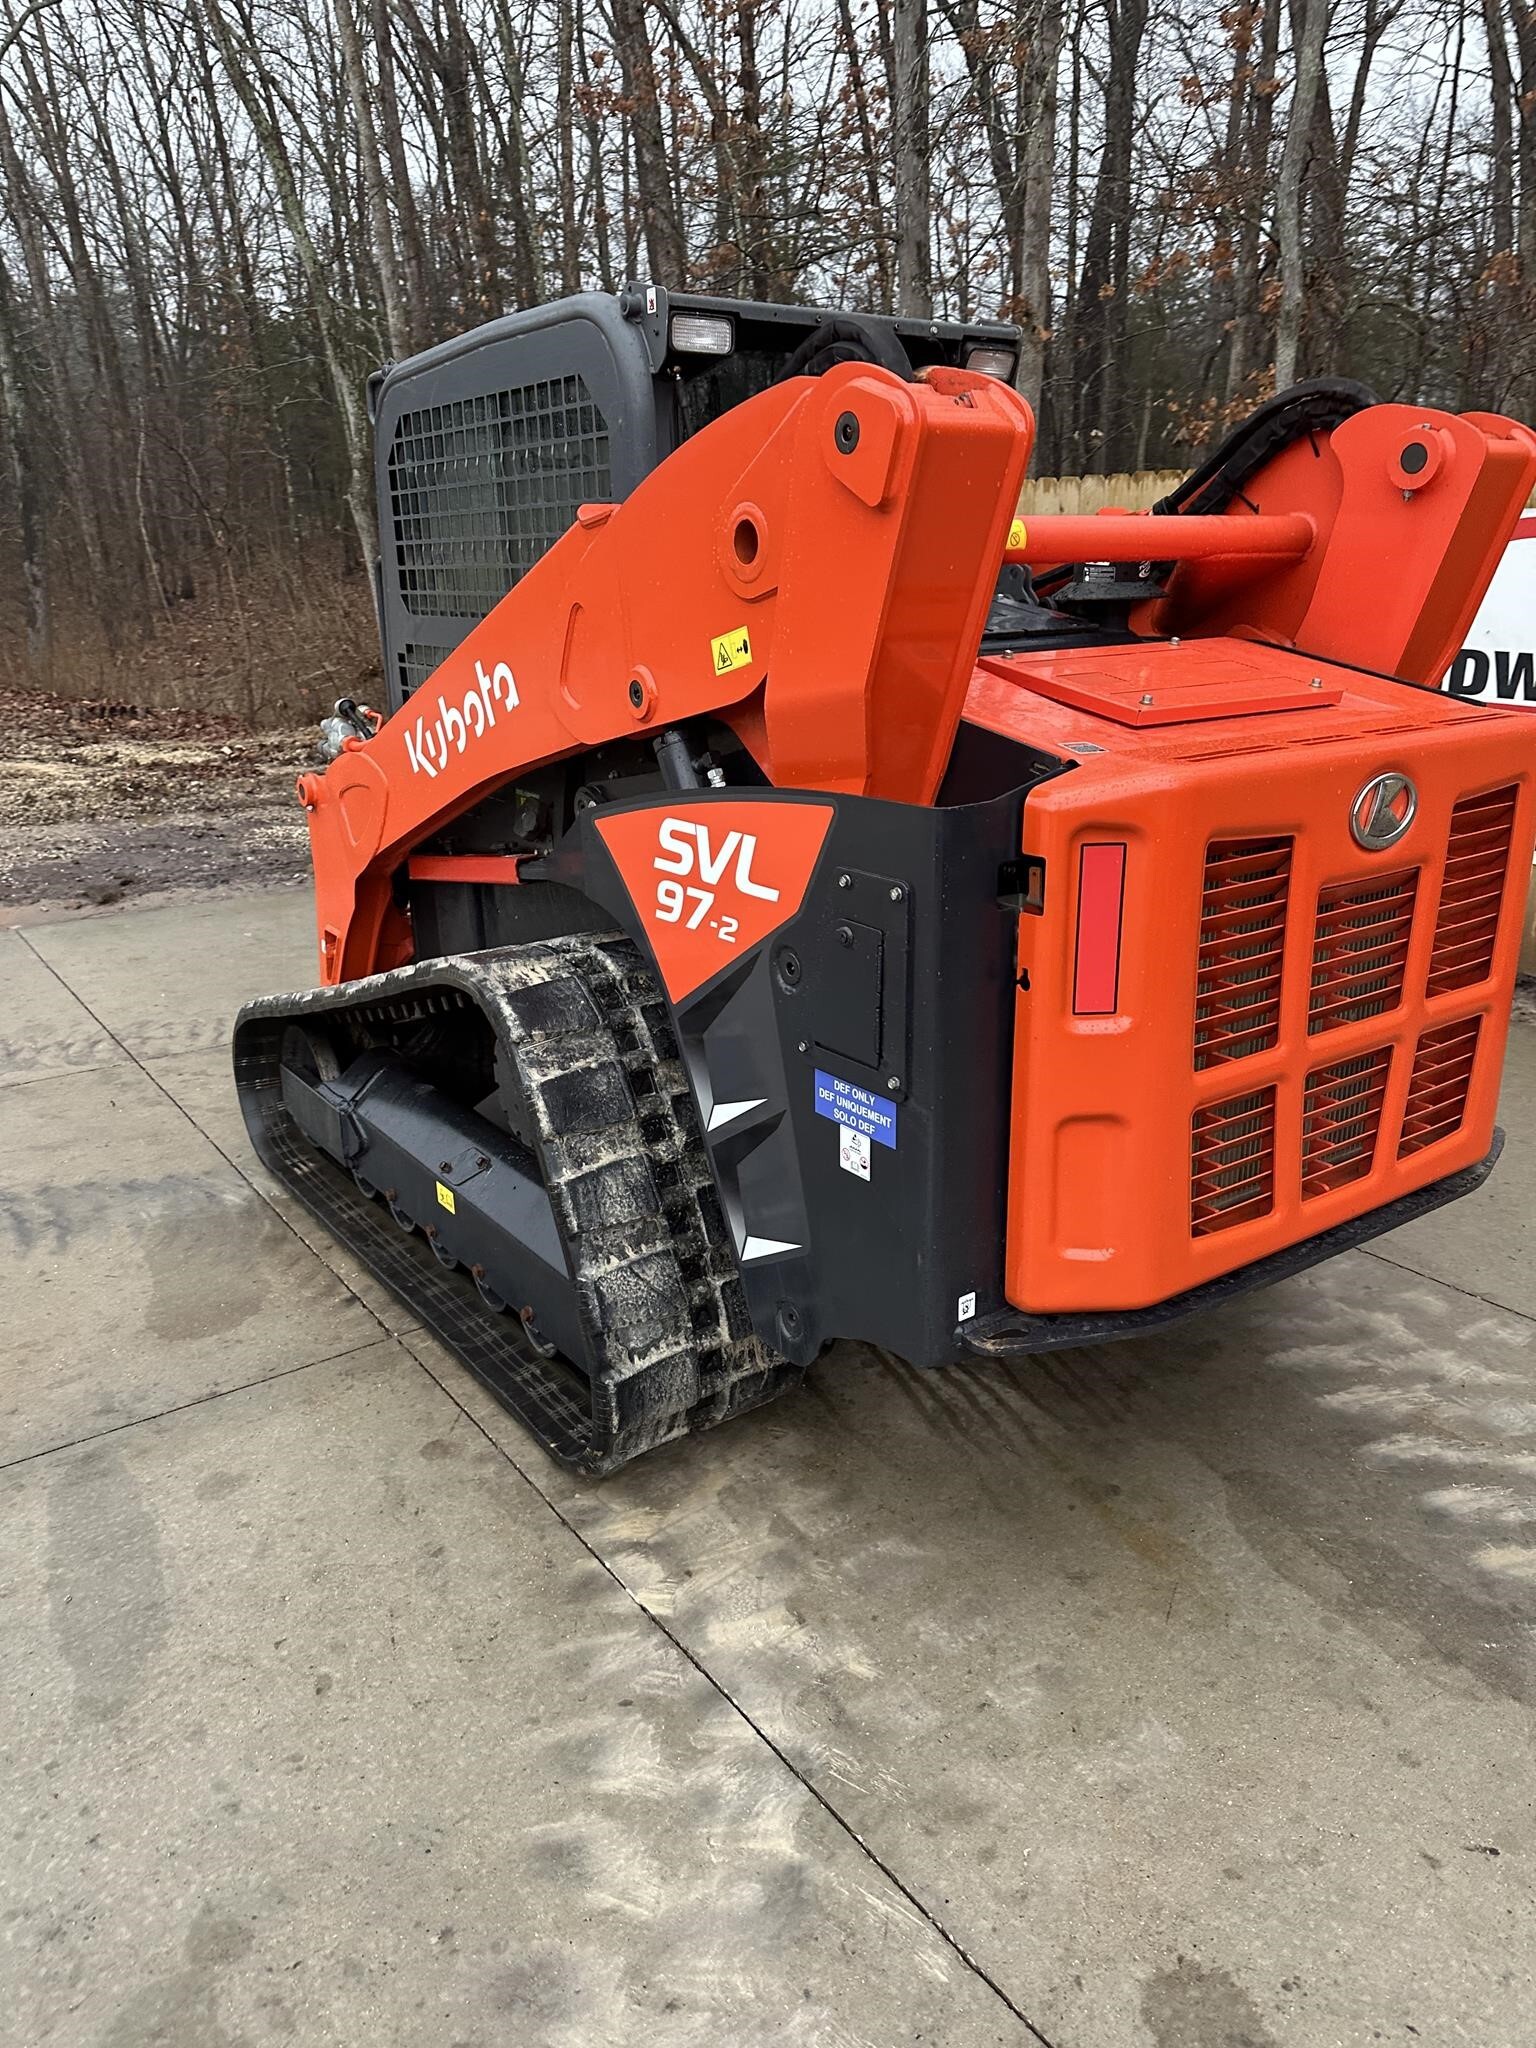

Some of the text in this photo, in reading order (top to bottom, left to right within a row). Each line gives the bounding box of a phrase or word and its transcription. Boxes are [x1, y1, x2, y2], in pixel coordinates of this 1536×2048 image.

[403, 659, 520, 778] Kubota
[653, 817, 780, 903] SVL
[819, 1087, 892, 1129] DEF UNIQUEMENT
[833, 1079, 875, 1107] DEF ONLY
[833, 1107, 876, 1135] SOLO DEF
